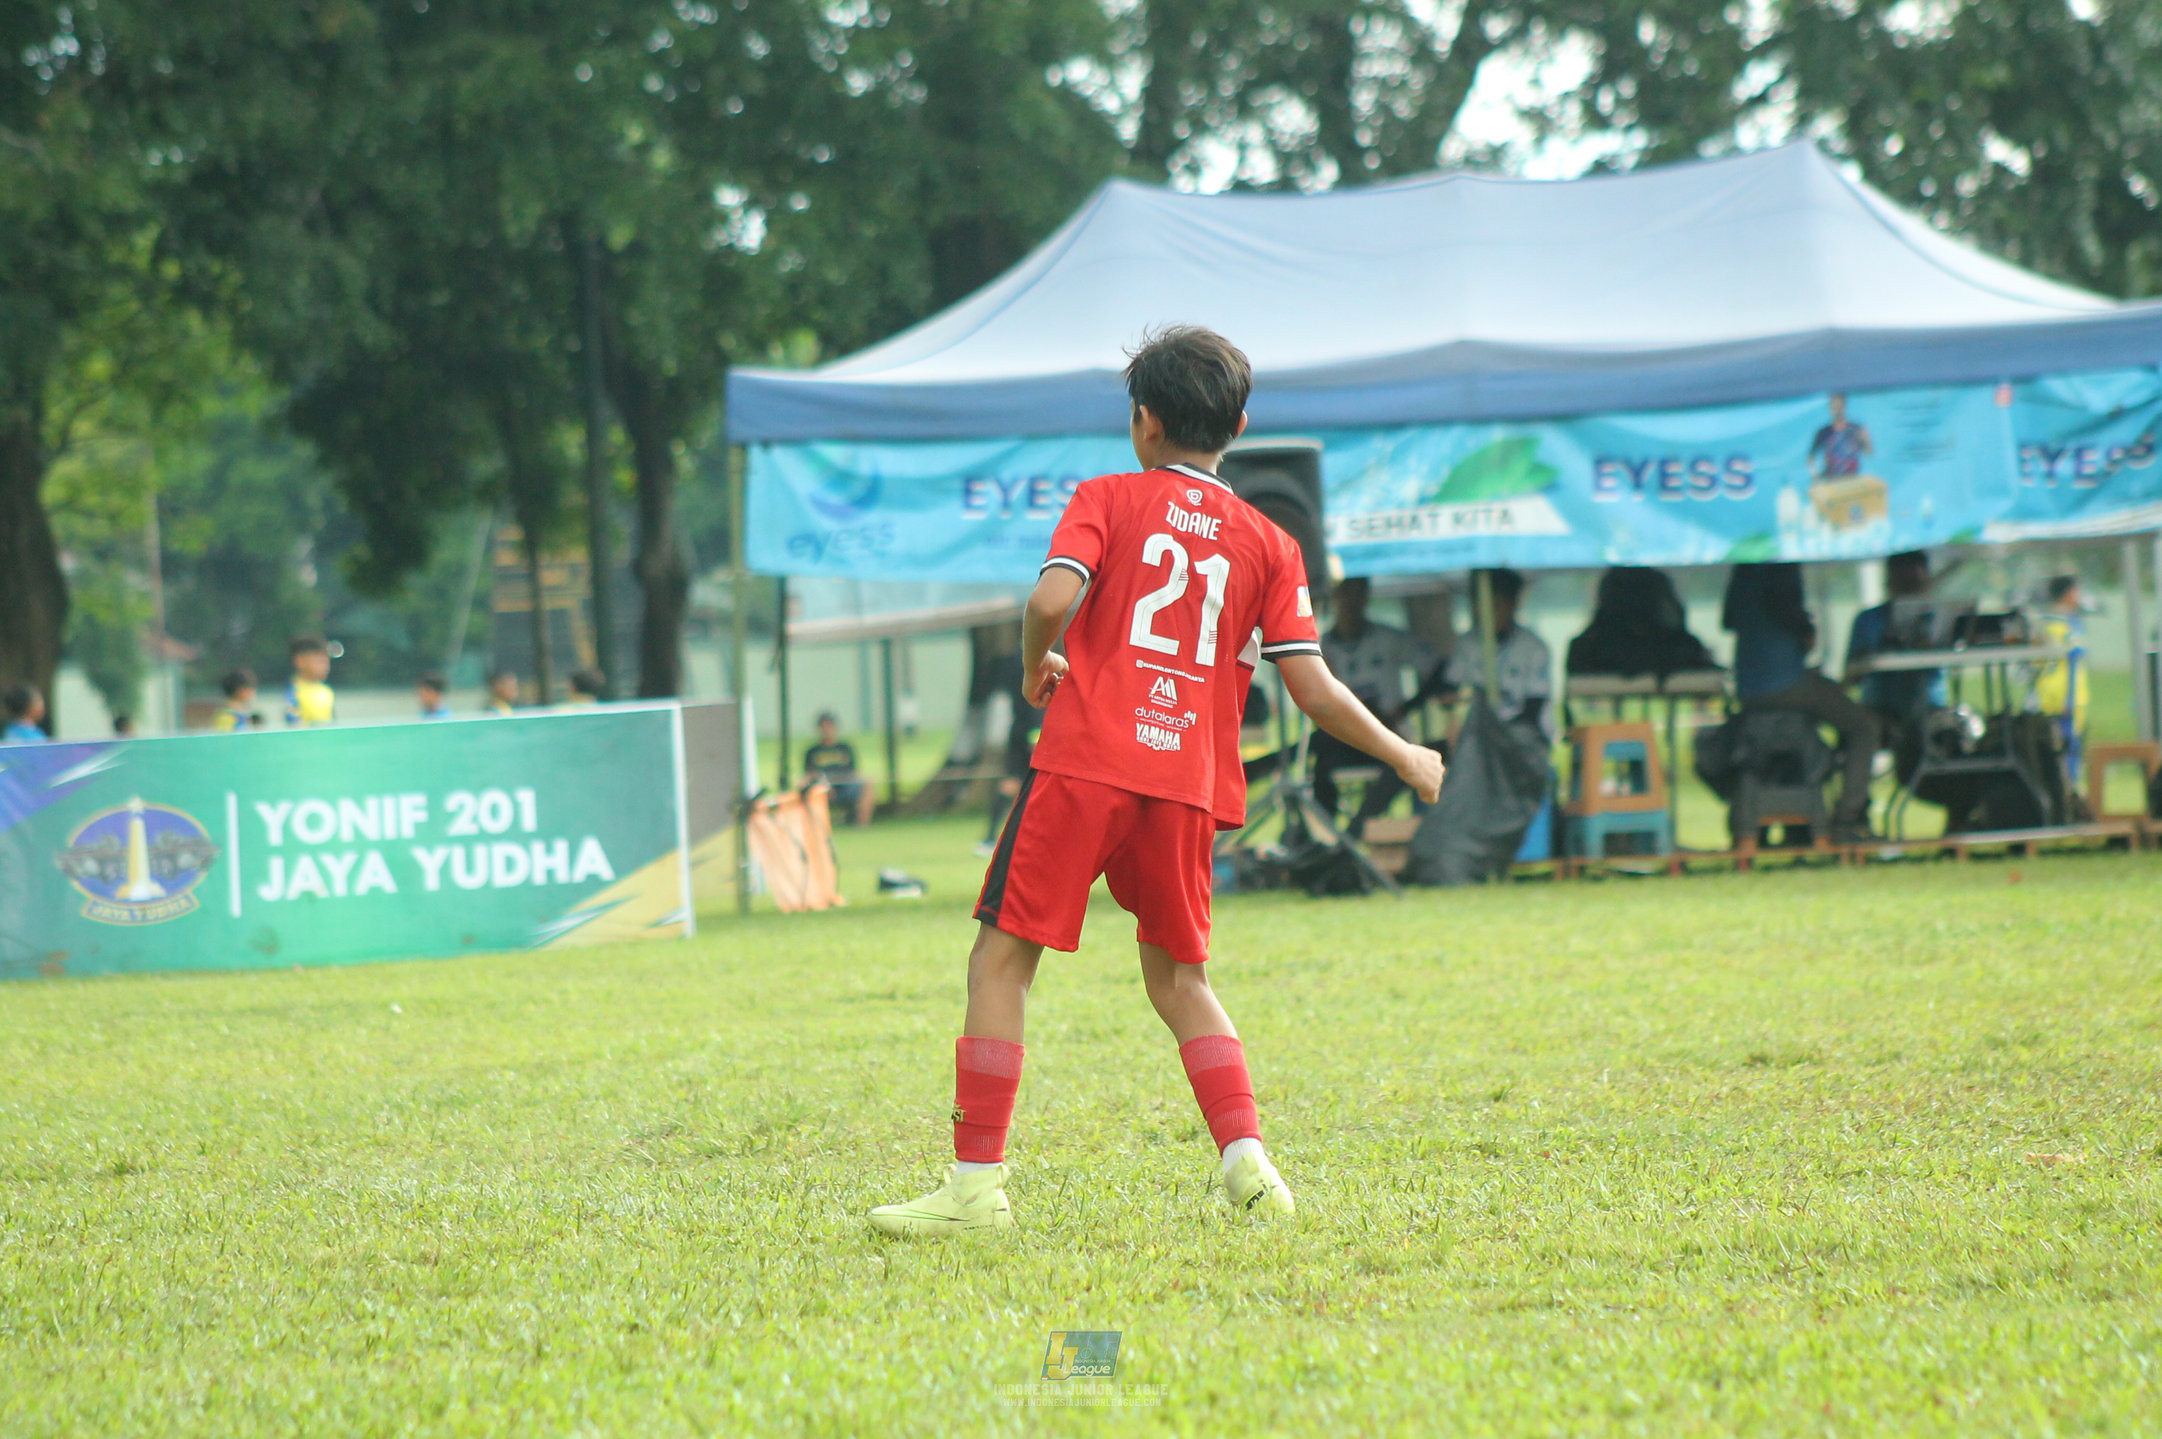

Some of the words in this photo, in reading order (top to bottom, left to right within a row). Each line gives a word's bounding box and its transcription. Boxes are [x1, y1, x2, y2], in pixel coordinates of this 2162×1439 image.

[962, 474, 1083, 519] EYES
[1592, 453, 1757, 501] EYESS
[1166, 501, 1222, 541] ZIDANE
[1349, 509, 1441, 539] SEHAT
[1453, 504, 1516, 531] KITA
[1129, 533, 1231, 667] 21
[1135, 706, 1190, 729] dutalaras
[1136, 722, 1181, 746] YAMAHA
[256, 792, 429, 847] YONIF
[445, 787, 538, 837] 201
[258, 850, 399, 901] JAYA
[411, 835, 615, 892] YUDHA
